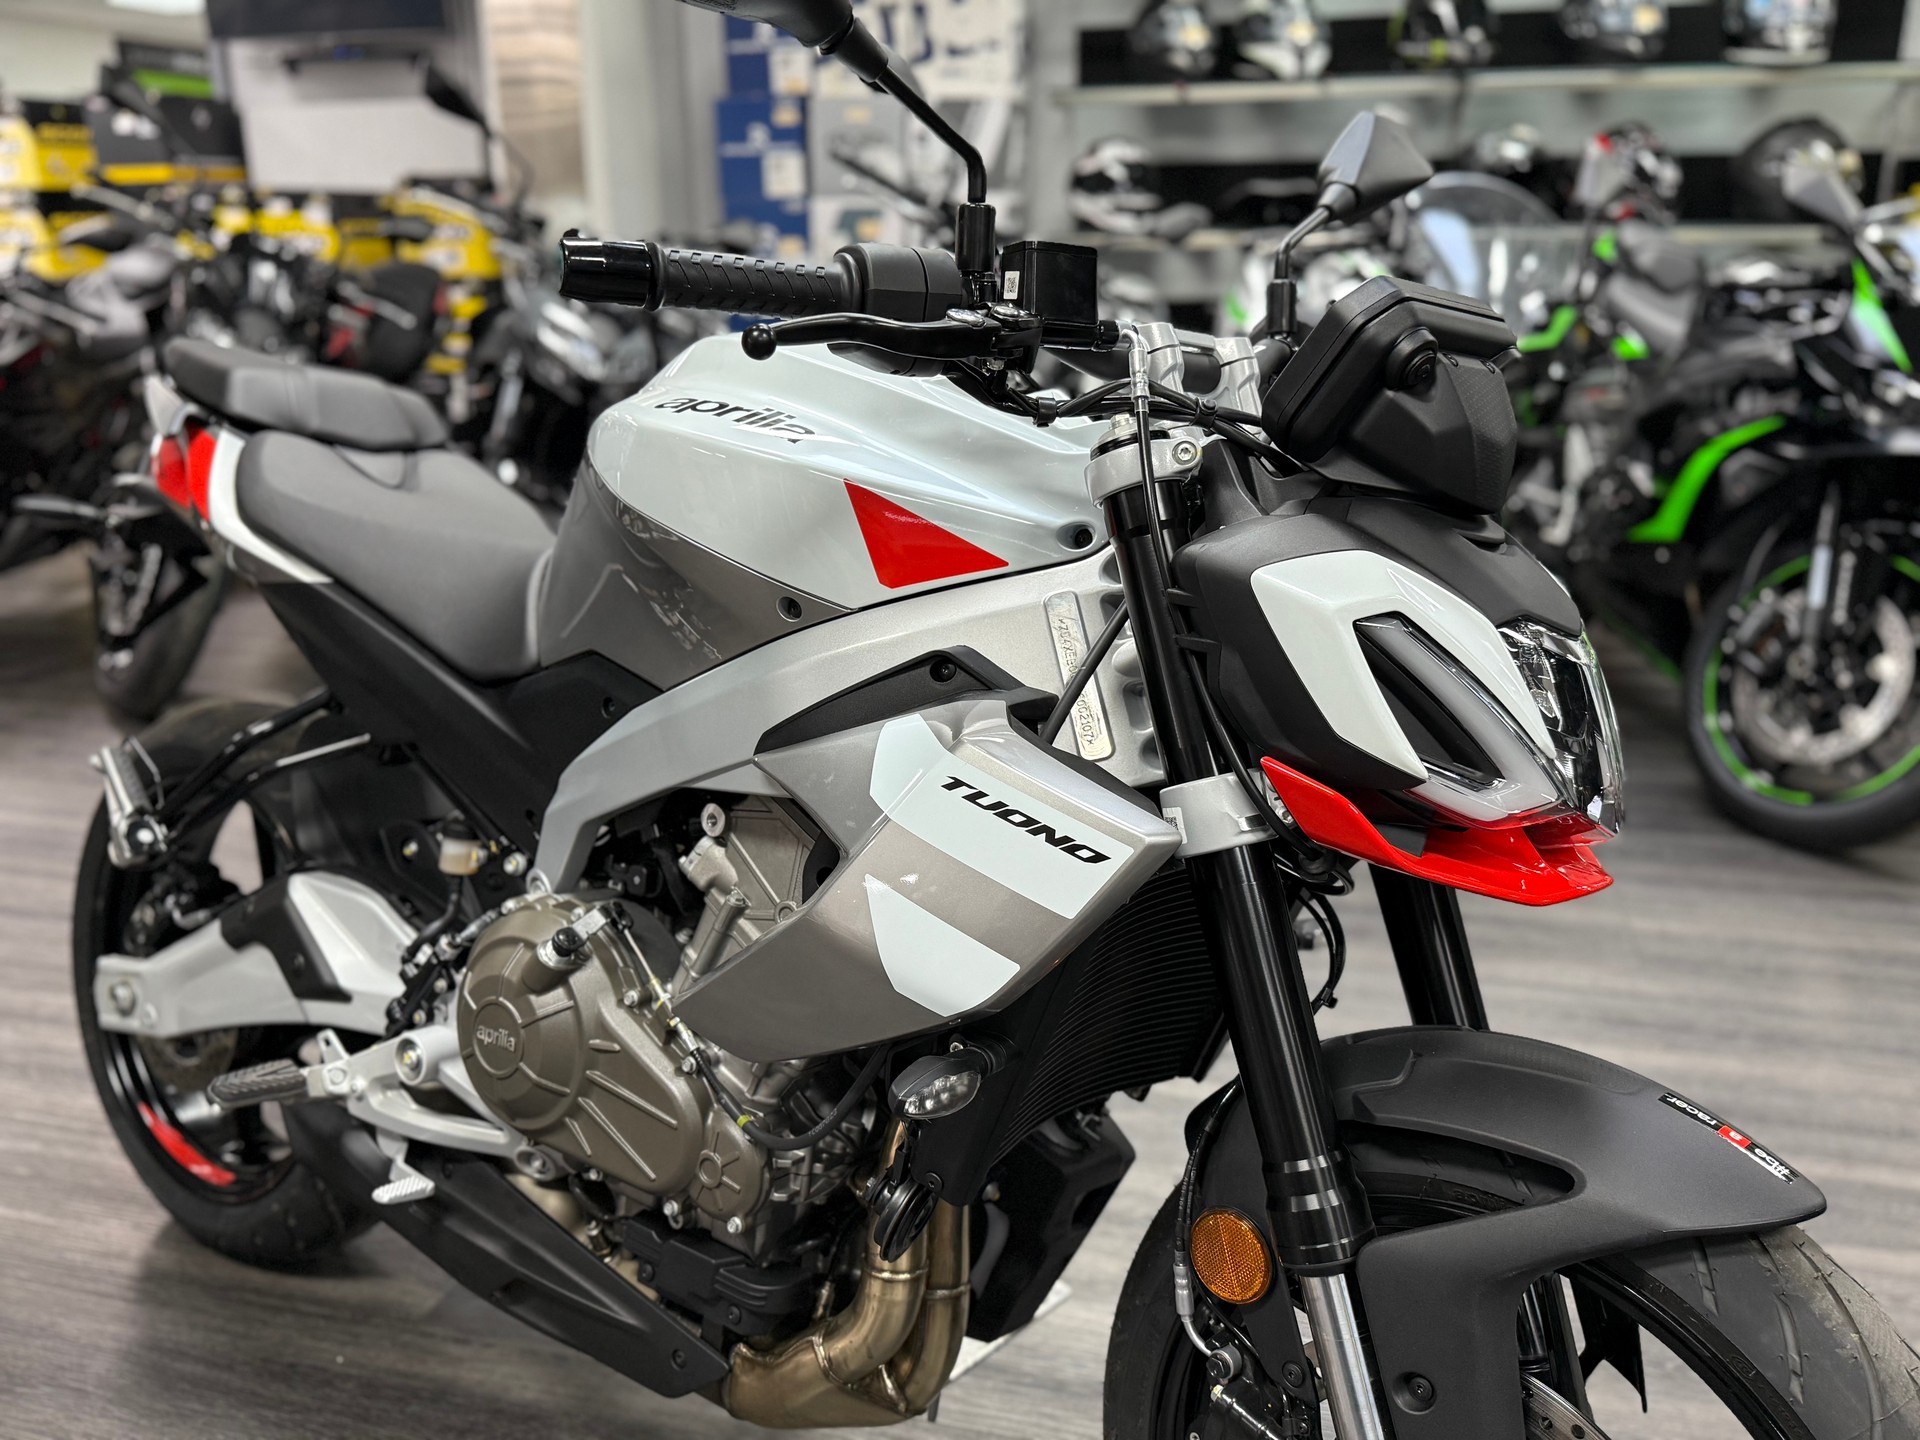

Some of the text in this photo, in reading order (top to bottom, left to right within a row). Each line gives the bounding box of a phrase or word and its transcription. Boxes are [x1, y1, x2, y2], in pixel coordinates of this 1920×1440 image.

[654, 397, 816, 444] aprilia
[941, 775, 1112, 864] TUONO
[476, 1025, 516, 1052] aprilia
[1728, 1130, 1743, 1141] a
